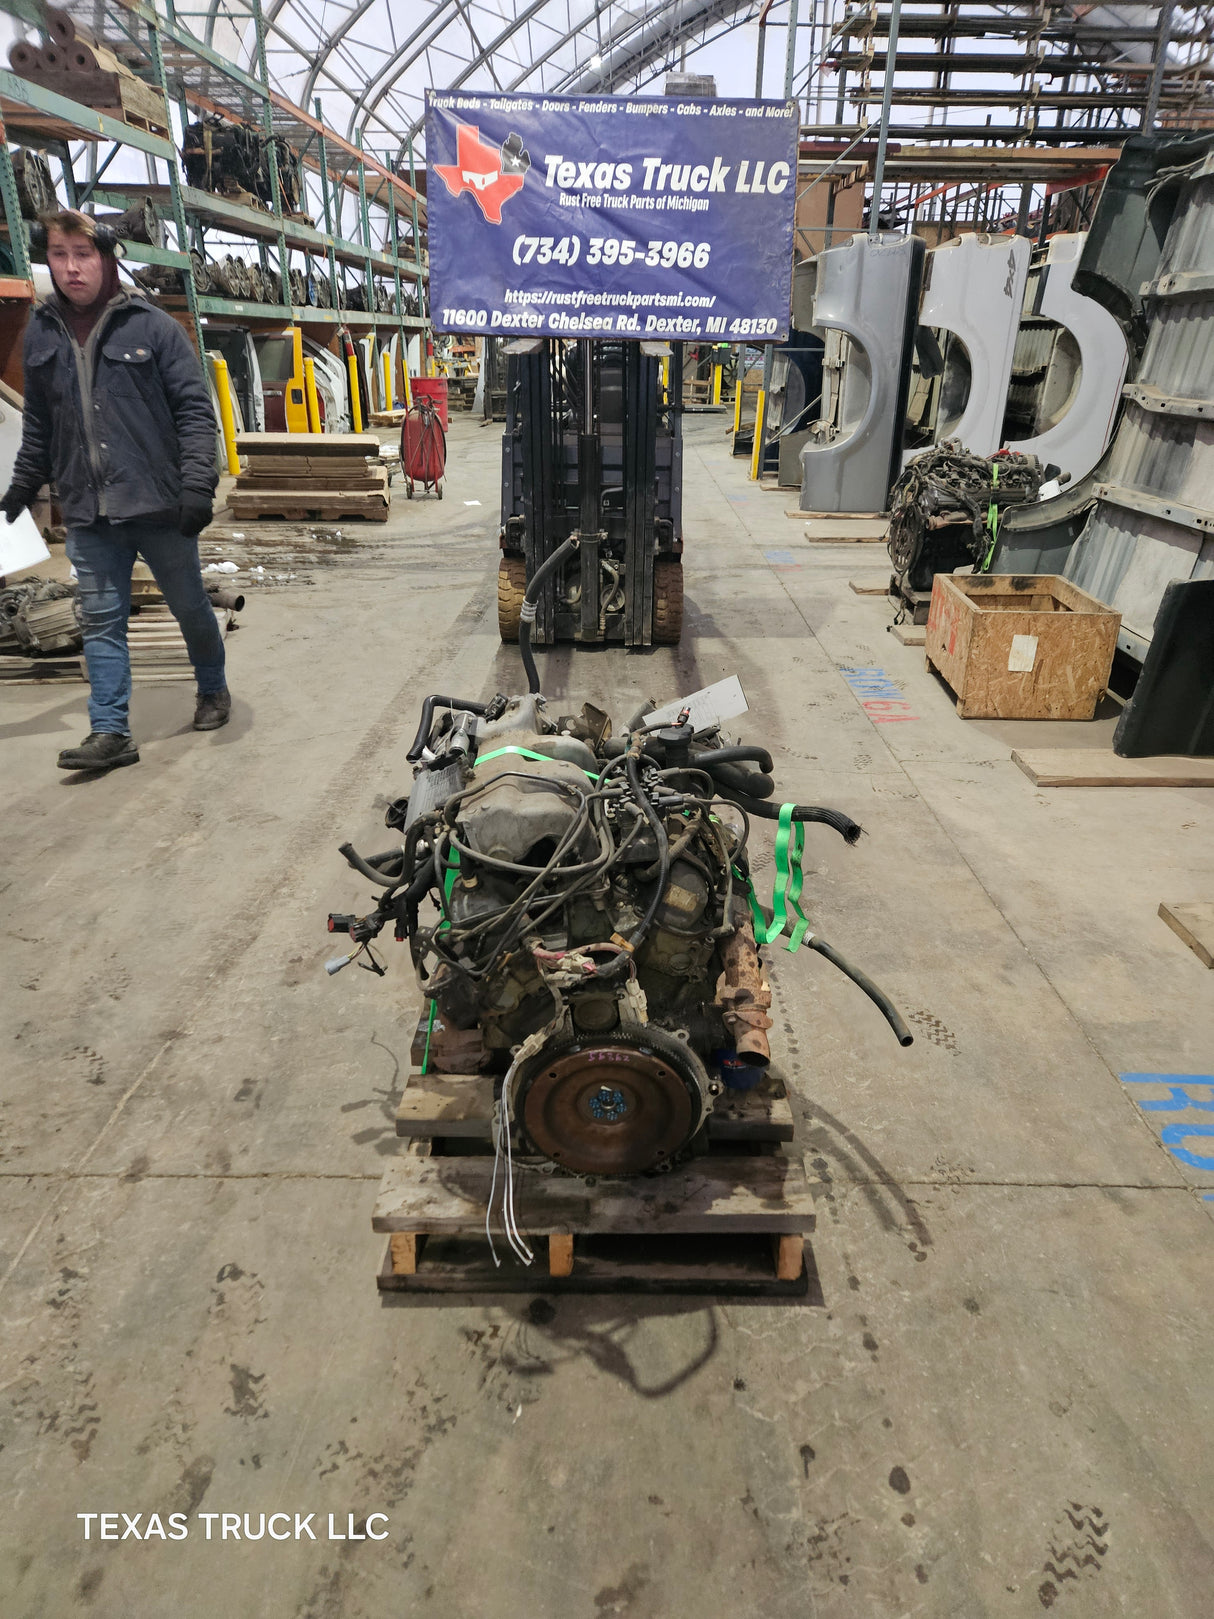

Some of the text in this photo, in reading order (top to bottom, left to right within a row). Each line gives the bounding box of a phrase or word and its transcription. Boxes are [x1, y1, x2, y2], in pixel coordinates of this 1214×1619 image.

[456, 98, 481, 109] Beds
[490, 98, 533, 111] Tailgates
[541, 100, 570, 112] Doors
[578, 101, 617, 113] Fenders
[625, 102, 668, 116] Bumpers
[677, 103, 701, 116] Cabs
[709, 105, 737, 117] Axles
[745, 105, 762, 117] and
[765, 106, 794, 118] More!
[544, 154, 790, 194] Texas Truck LLC
[559, 192, 709, 212] Rust Free Truck Parts of Michigan
[512, 234, 711, 268] (734) 395-3966
[504, 288, 716, 309] https://rustfreetruckpartsmi.com/
[442, 308, 778, 335] 11600 Dexter Chelsea Rd. Dexter, MI 48130
